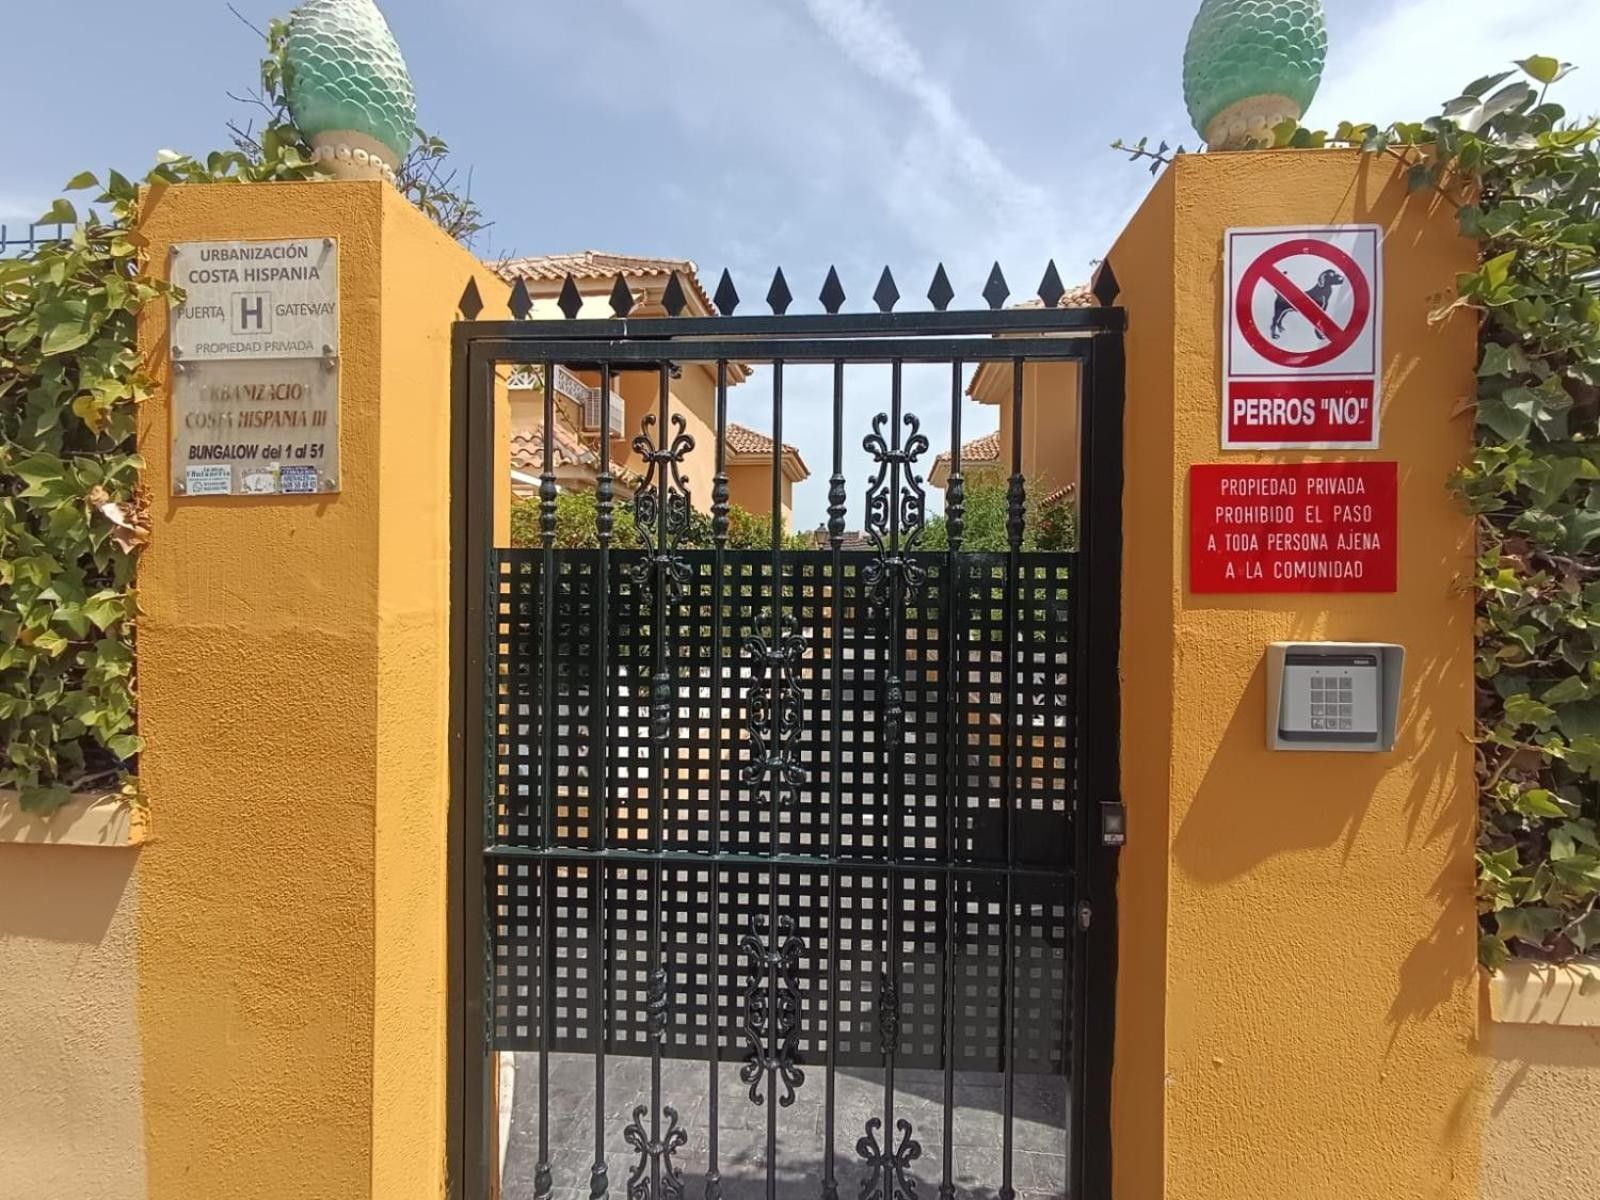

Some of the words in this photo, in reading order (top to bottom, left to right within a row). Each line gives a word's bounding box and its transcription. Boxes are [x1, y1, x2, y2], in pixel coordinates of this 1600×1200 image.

[200, 244, 308, 261] URBANIZACIÓN
[189, 269, 239, 283] COSTA
[244, 266, 320, 281] HISPANIA
[177, 306, 224, 319] PUERTA
[241, 297, 263, 329] H
[275, 303, 336, 316] GATEWAY
[196, 342, 261, 353] PROPIEDAD
[265, 340, 314, 351] PRIVADA
[238, 410, 307, 428] HISPANIA
[312, 410, 327, 426] III
[1233, 398, 1315, 426] PERROS
[1321, 397, 1368, 425] "NO"
[188, 445, 259, 460] BUNGALOW
[262, 445, 281, 459] del
[285, 444, 293, 458] 1
[295, 444, 307, 459] al
[310, 444, 324, 458] 51
[1221, 478, 1296, 496] PROPIEDAD
[1307, 477, 1365, 495] PRIVADA
[1216, 506, 1294, 524] PROHIBIDO
[1306, 506, 1322, 523] EL
[1333, 505, 1372, 523] PASO
[1207, 534, 1217, 551] A
[1226, 534, 1259, 551] TODA
[1268, 533, 1328, 551] PERSONA
[1225, 562, 1235, 579] A
[1246, 561, 1263, 579] LA
[1274, 561, 1363, 579] COMUNIDAD
